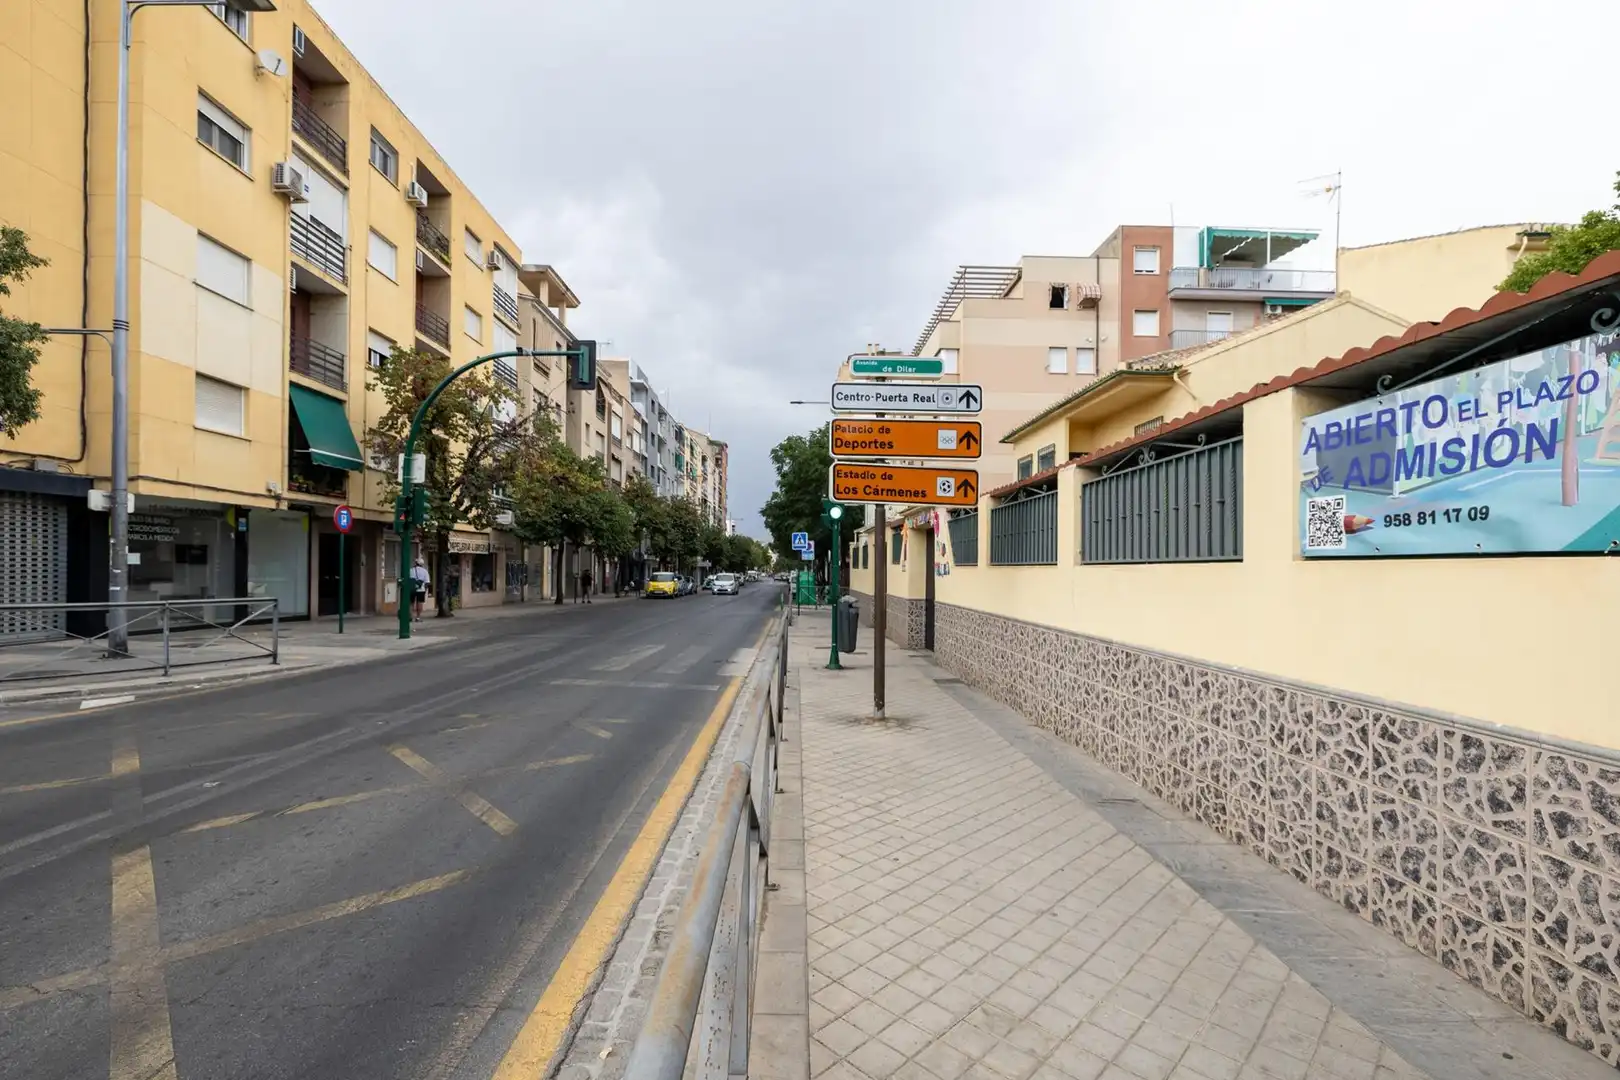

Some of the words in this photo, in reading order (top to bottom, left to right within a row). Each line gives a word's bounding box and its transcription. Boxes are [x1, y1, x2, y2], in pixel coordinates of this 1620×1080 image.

[882, 365, 893, 373] de
[896, 365, 917, 373] Dilar
[836, 391, 908, 403] Centro-Puerta
[912, 392, 936, 403] Real
[1302, 394, 1449, 456] ABIERTO
[1457, 399, 1489, 423] EL
[1497, 369, 1600, 414] PLAZO
[834, 424, 874, 434] Palacio
[878, 425, 891, 435] de
[834, 437, 894, 451] Deportes
[1309, 465, 1334, 493] DE
[1342, 417, 1559, 490] ADMISIÓN
[836, 469, 876, 480] Estadio
[880, 471, 894, 481] de
[836, 484, 858, 495] Los
[862, 484, 928, 499] Cármenes
[1383, 511, 1412, 529] 958
[1416, 509, 1437, 526] 81
[1442, 507, 1463, 524] 17
[1467, 505, 1491, 523] 09
